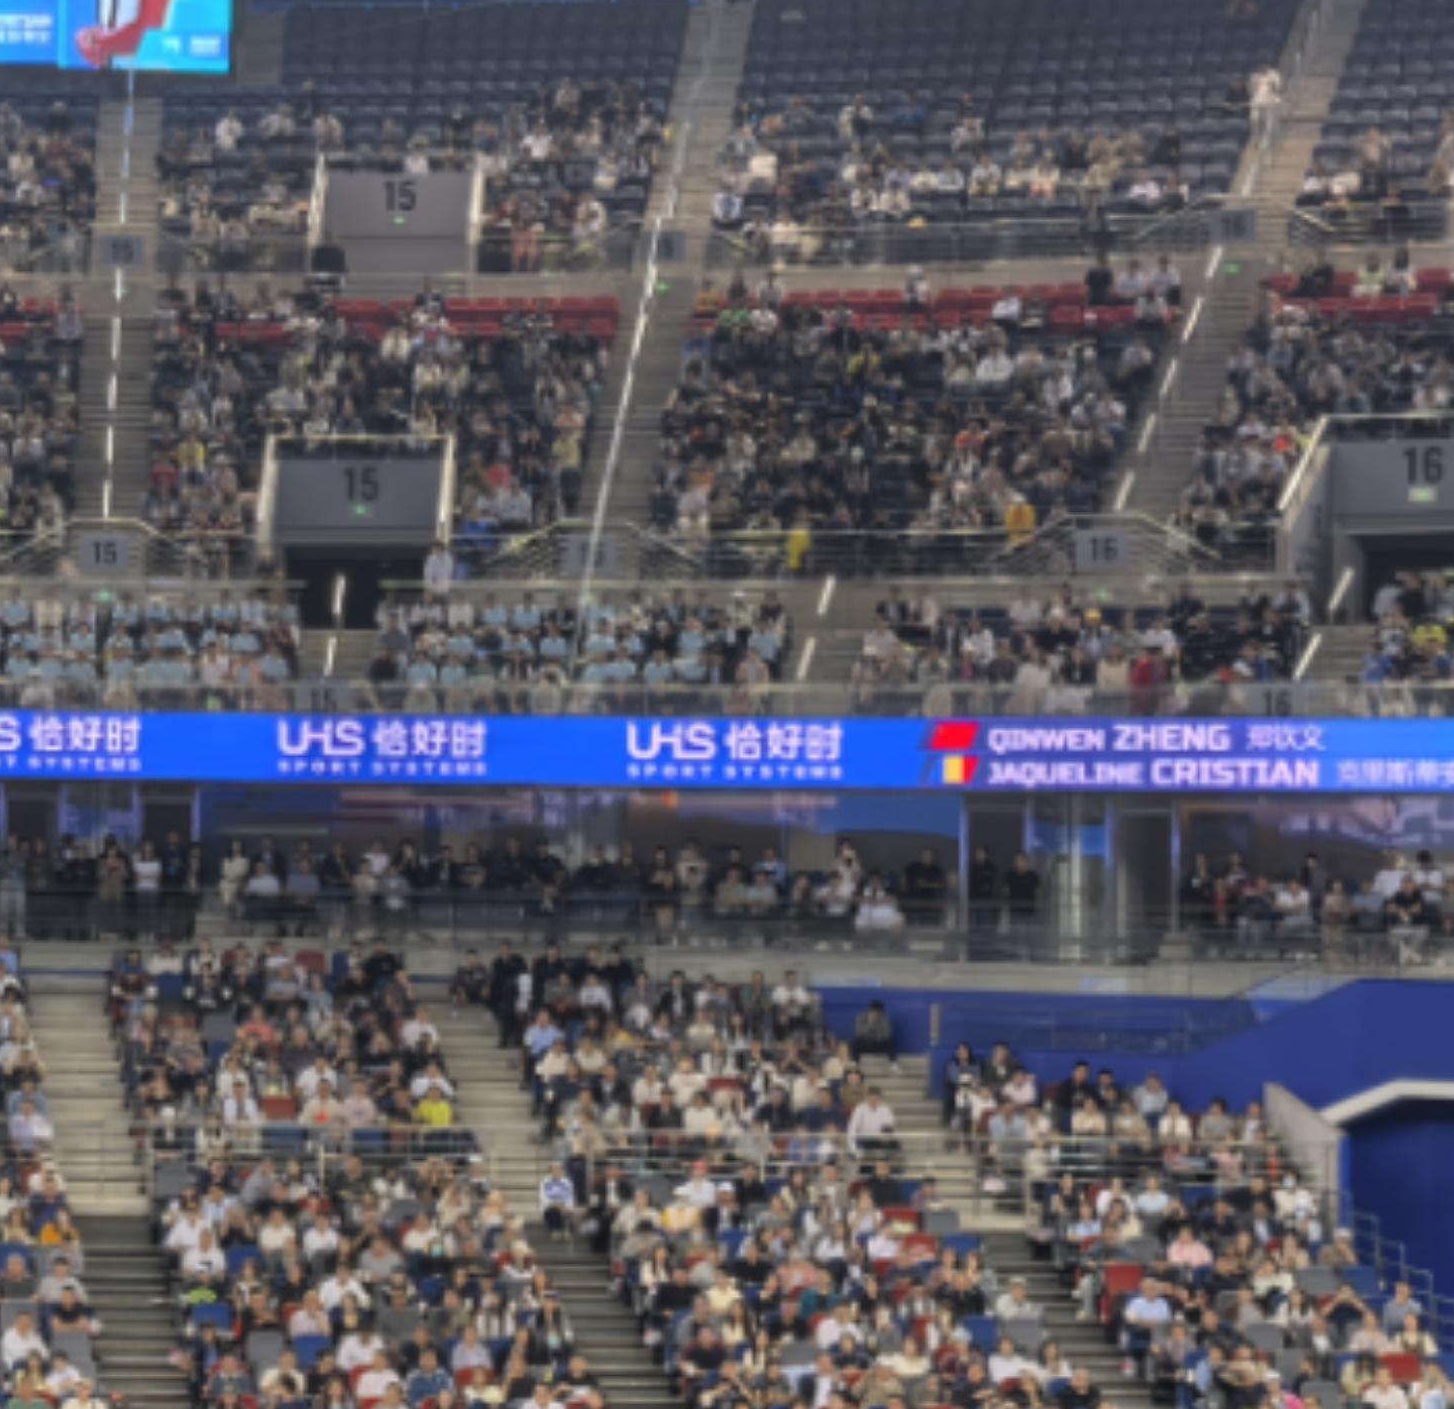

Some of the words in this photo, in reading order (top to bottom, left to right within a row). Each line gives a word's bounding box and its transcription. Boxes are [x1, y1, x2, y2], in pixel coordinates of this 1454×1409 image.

[384, 181, 417, 212] 15
[1404, 446, 1444, 485] 16
[344, 466, 380, 502] 15
[93, 541, 118, 566] 15
[29, 717, 141, 754] 恰好时
[372, 720, 487, 758] 恰好时
[725, 722, 843, 761] 恰好时
[988, 728, 1105, 753] QINWEN
[1113, 724, 1231, 752] ZHENG
[988, 761, 1144, 787] JAQUELINE
[1151, 758, 1320, 787] CRISTIAN
